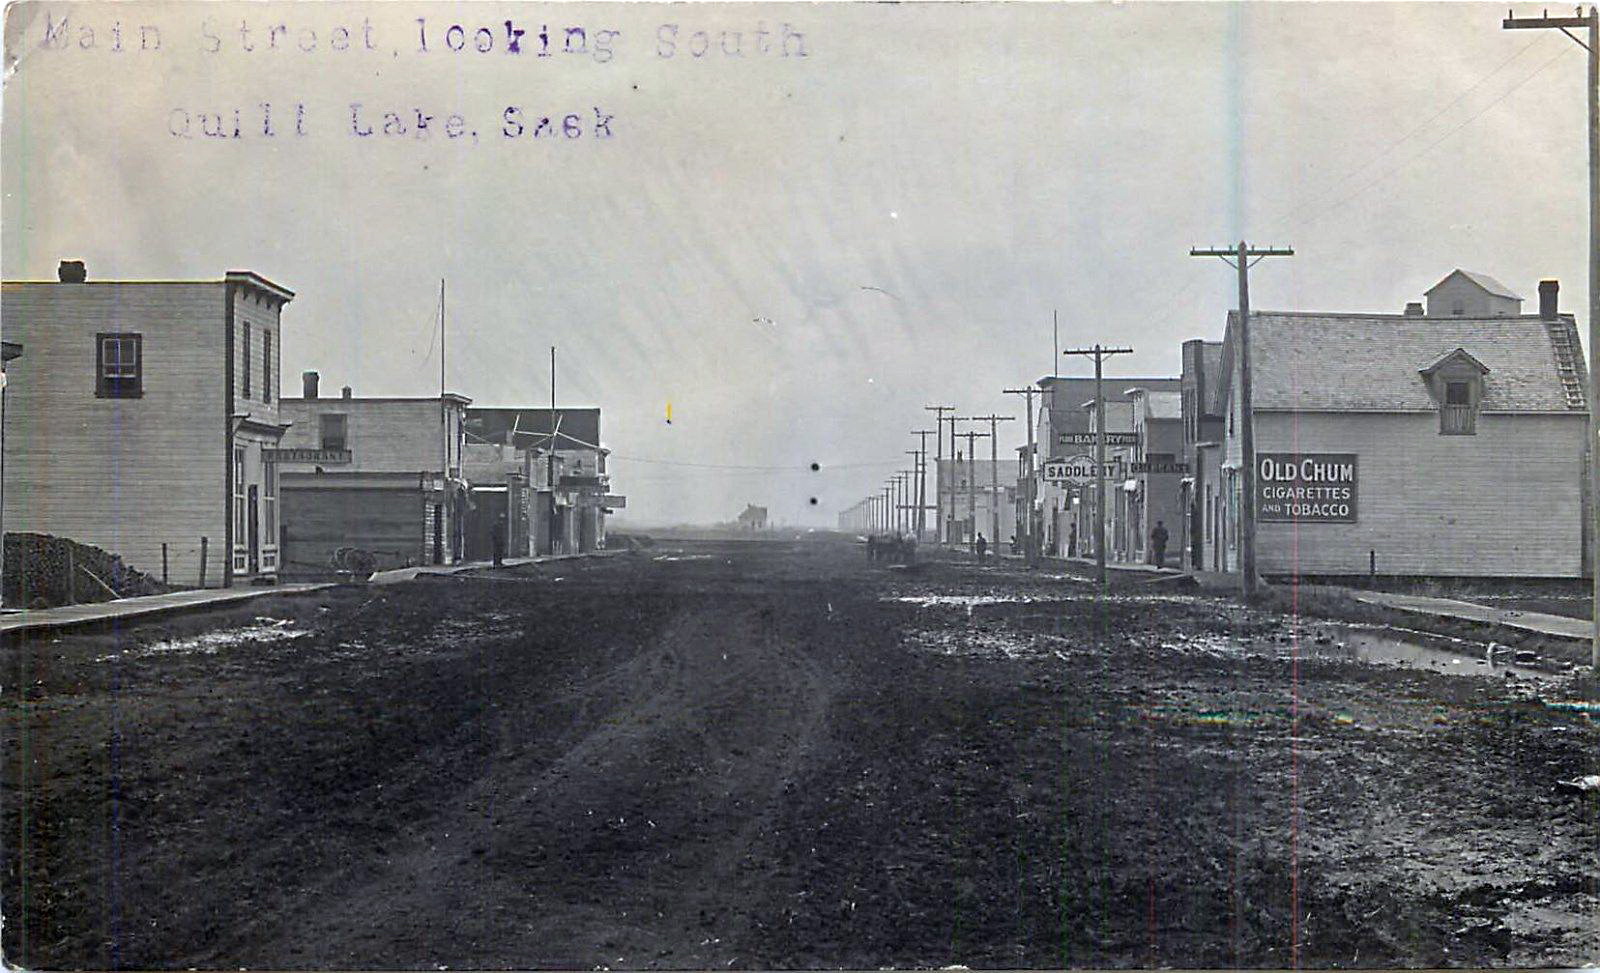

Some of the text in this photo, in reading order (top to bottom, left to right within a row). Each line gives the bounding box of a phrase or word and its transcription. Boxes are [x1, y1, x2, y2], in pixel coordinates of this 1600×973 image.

[1074, 434, 1122, 444] BAKRY
[1262, 486, 1351, 500] CIGARETTES
[1262, 503, 1350, 517] AND TOBACCO
